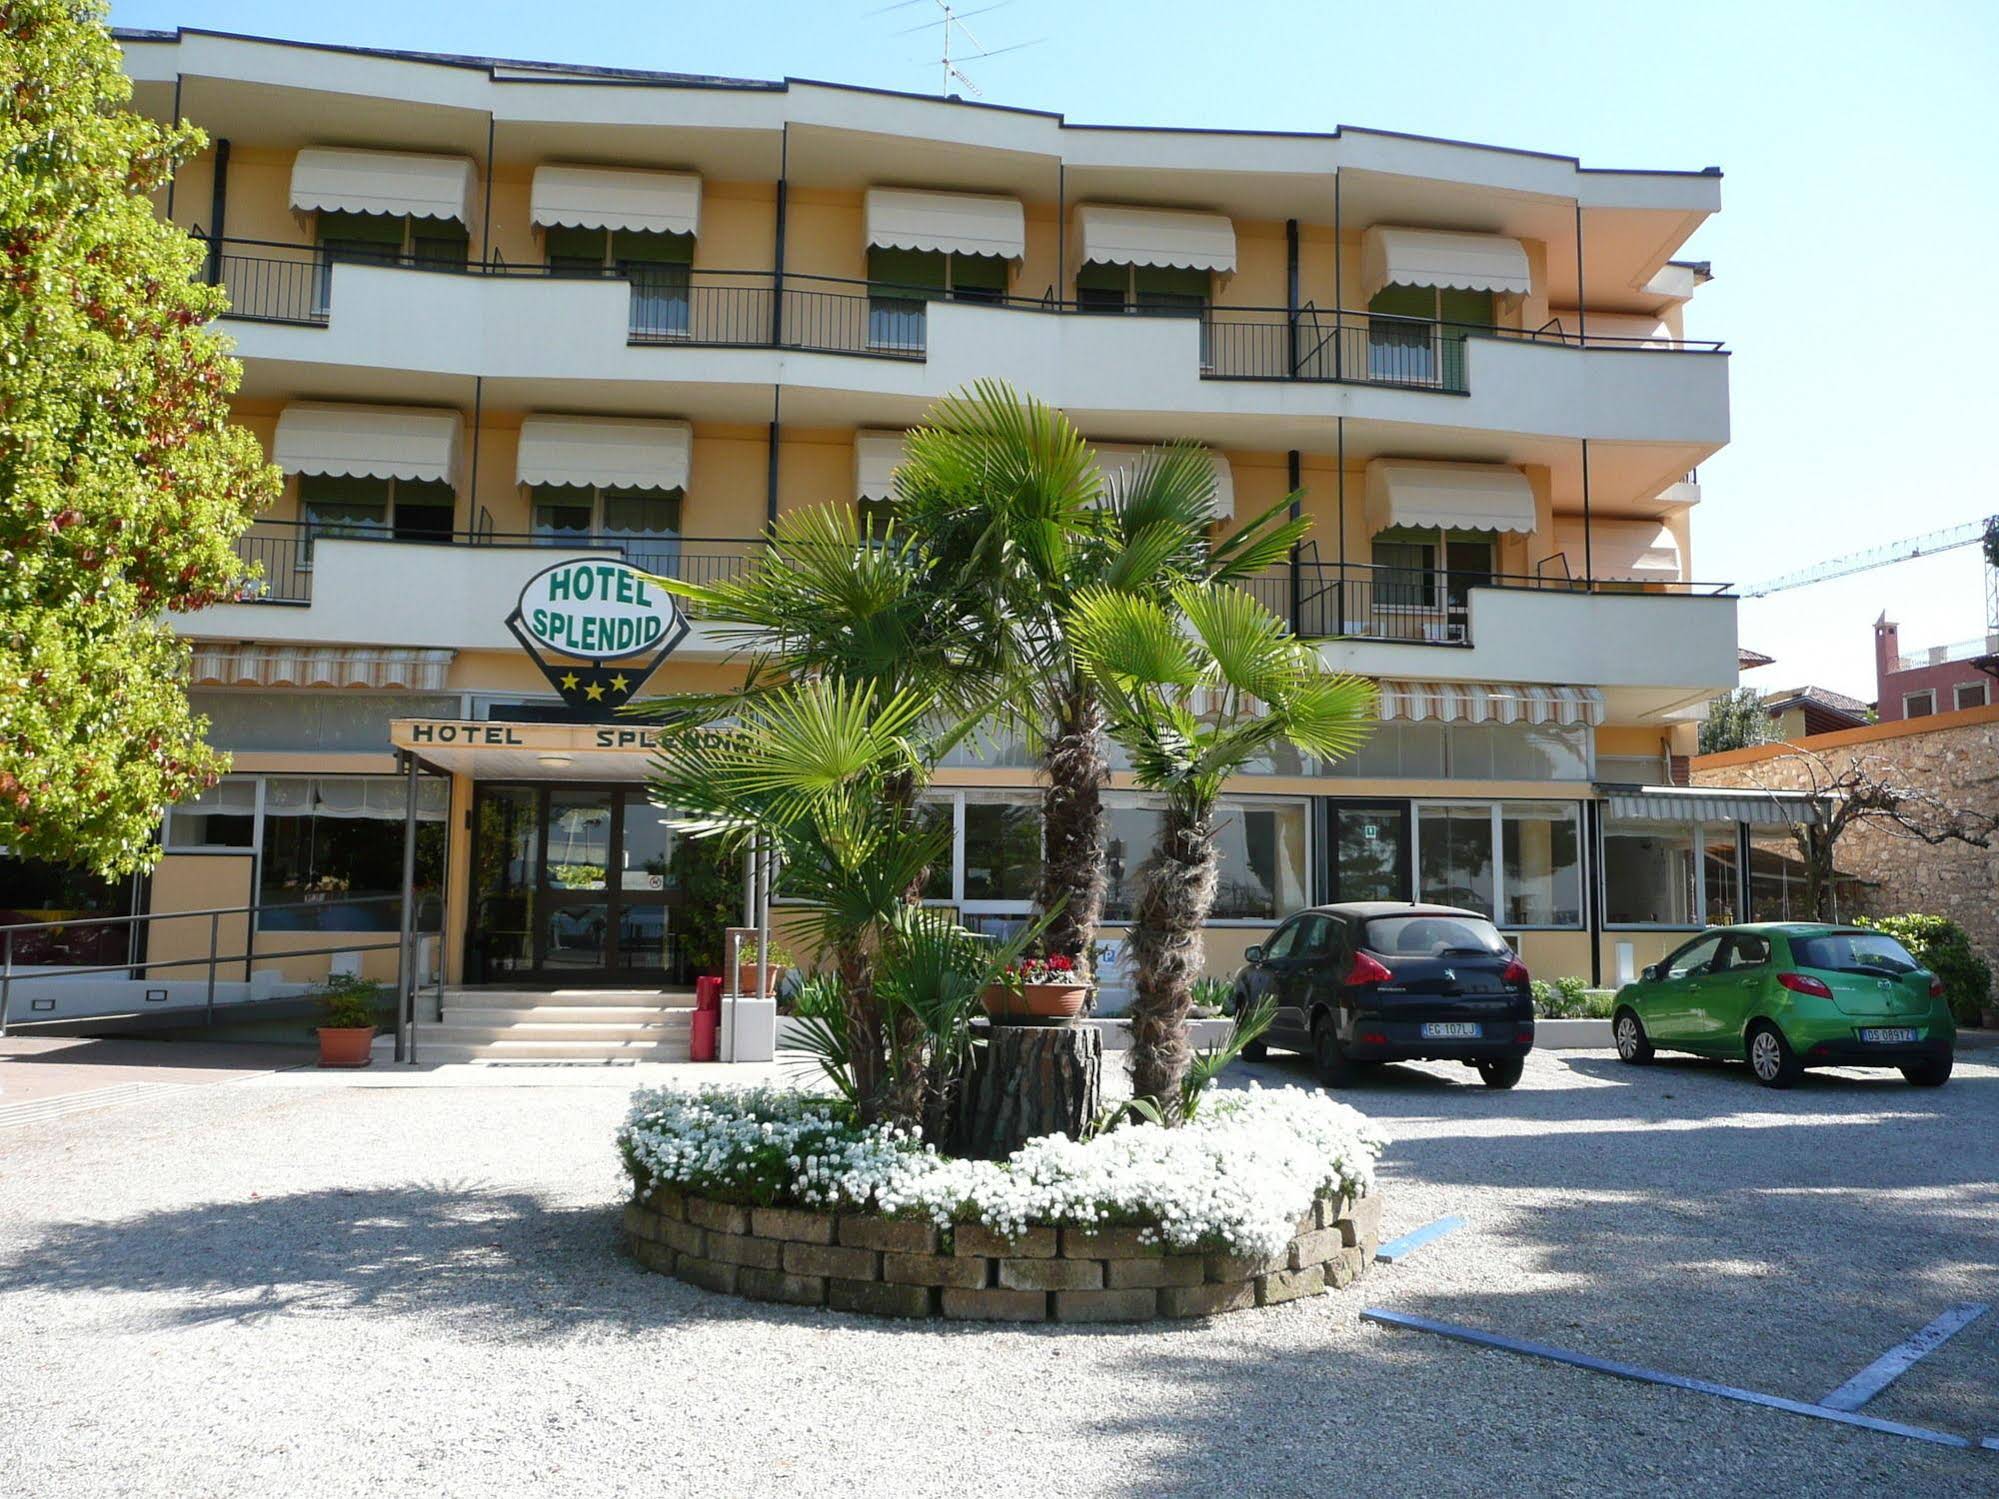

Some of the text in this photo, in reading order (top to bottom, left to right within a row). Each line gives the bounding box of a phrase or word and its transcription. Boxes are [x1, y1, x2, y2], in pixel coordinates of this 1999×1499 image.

[550, 566, 652, 608] HOTEL
[533, 609, 661, 651] SPLENDID
[413, 725, 522, 744] HOTEL
